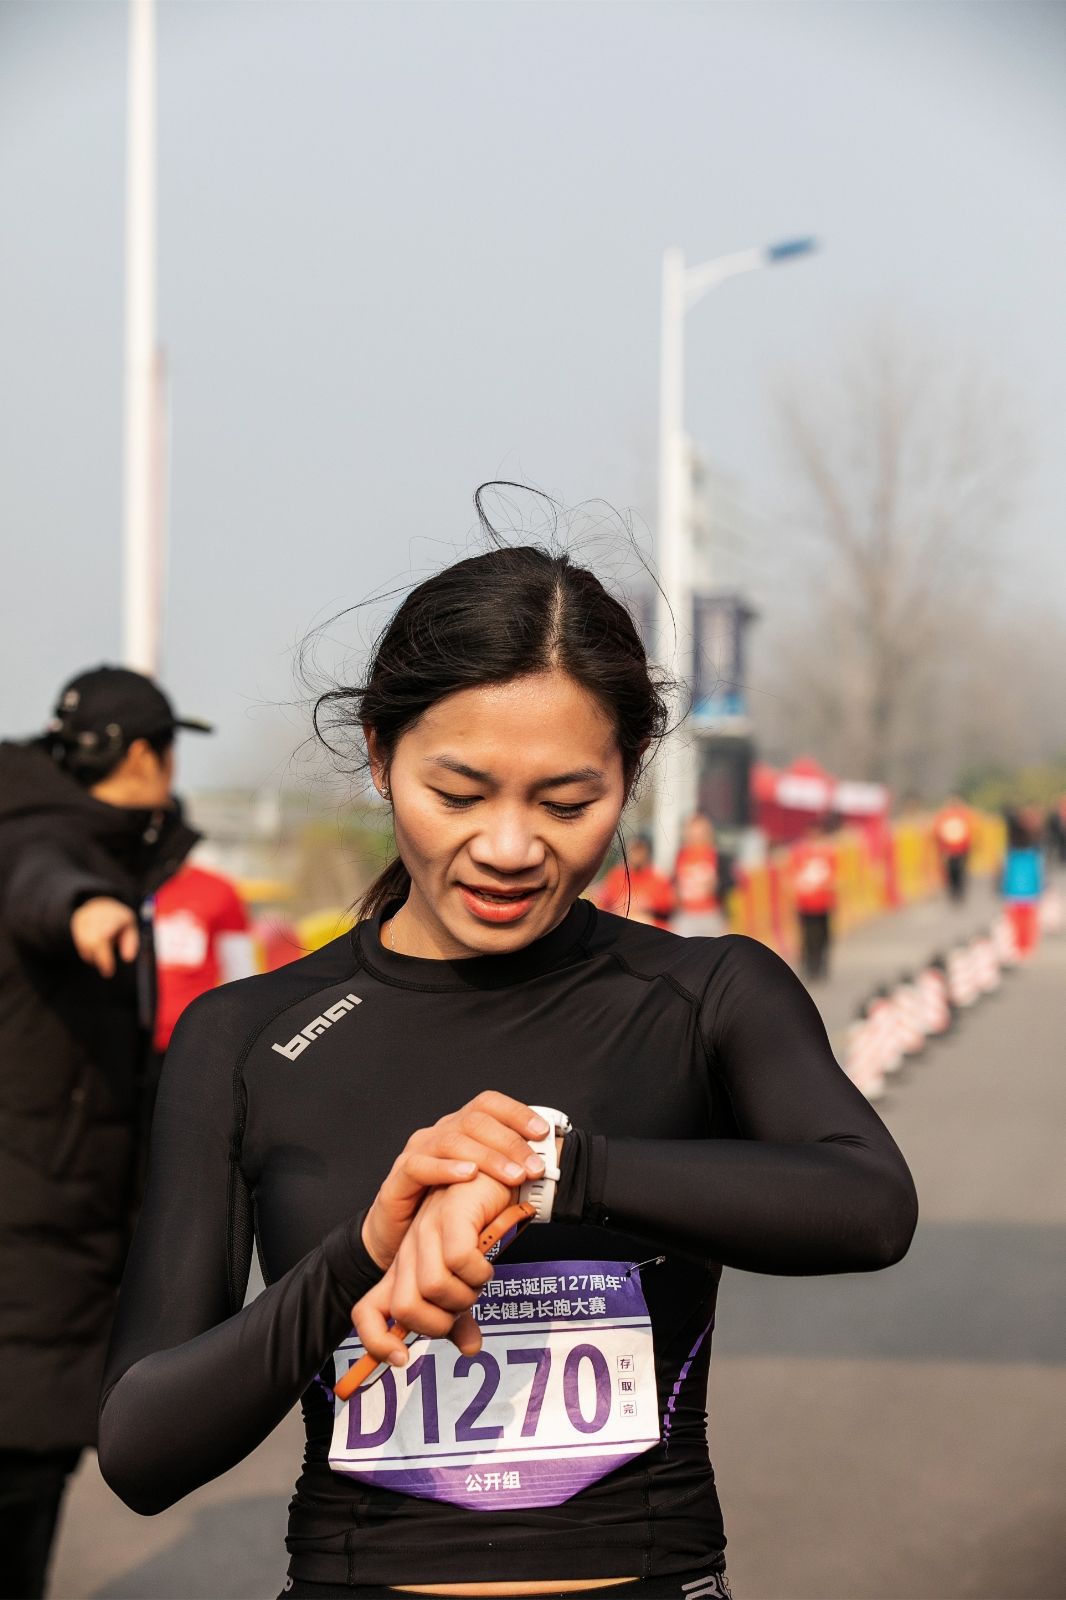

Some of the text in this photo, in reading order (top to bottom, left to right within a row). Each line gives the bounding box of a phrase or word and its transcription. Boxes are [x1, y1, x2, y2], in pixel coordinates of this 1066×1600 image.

[346, 1343, 612, 1450] D1270
[465, 1471, 521, 1492] 公开组
